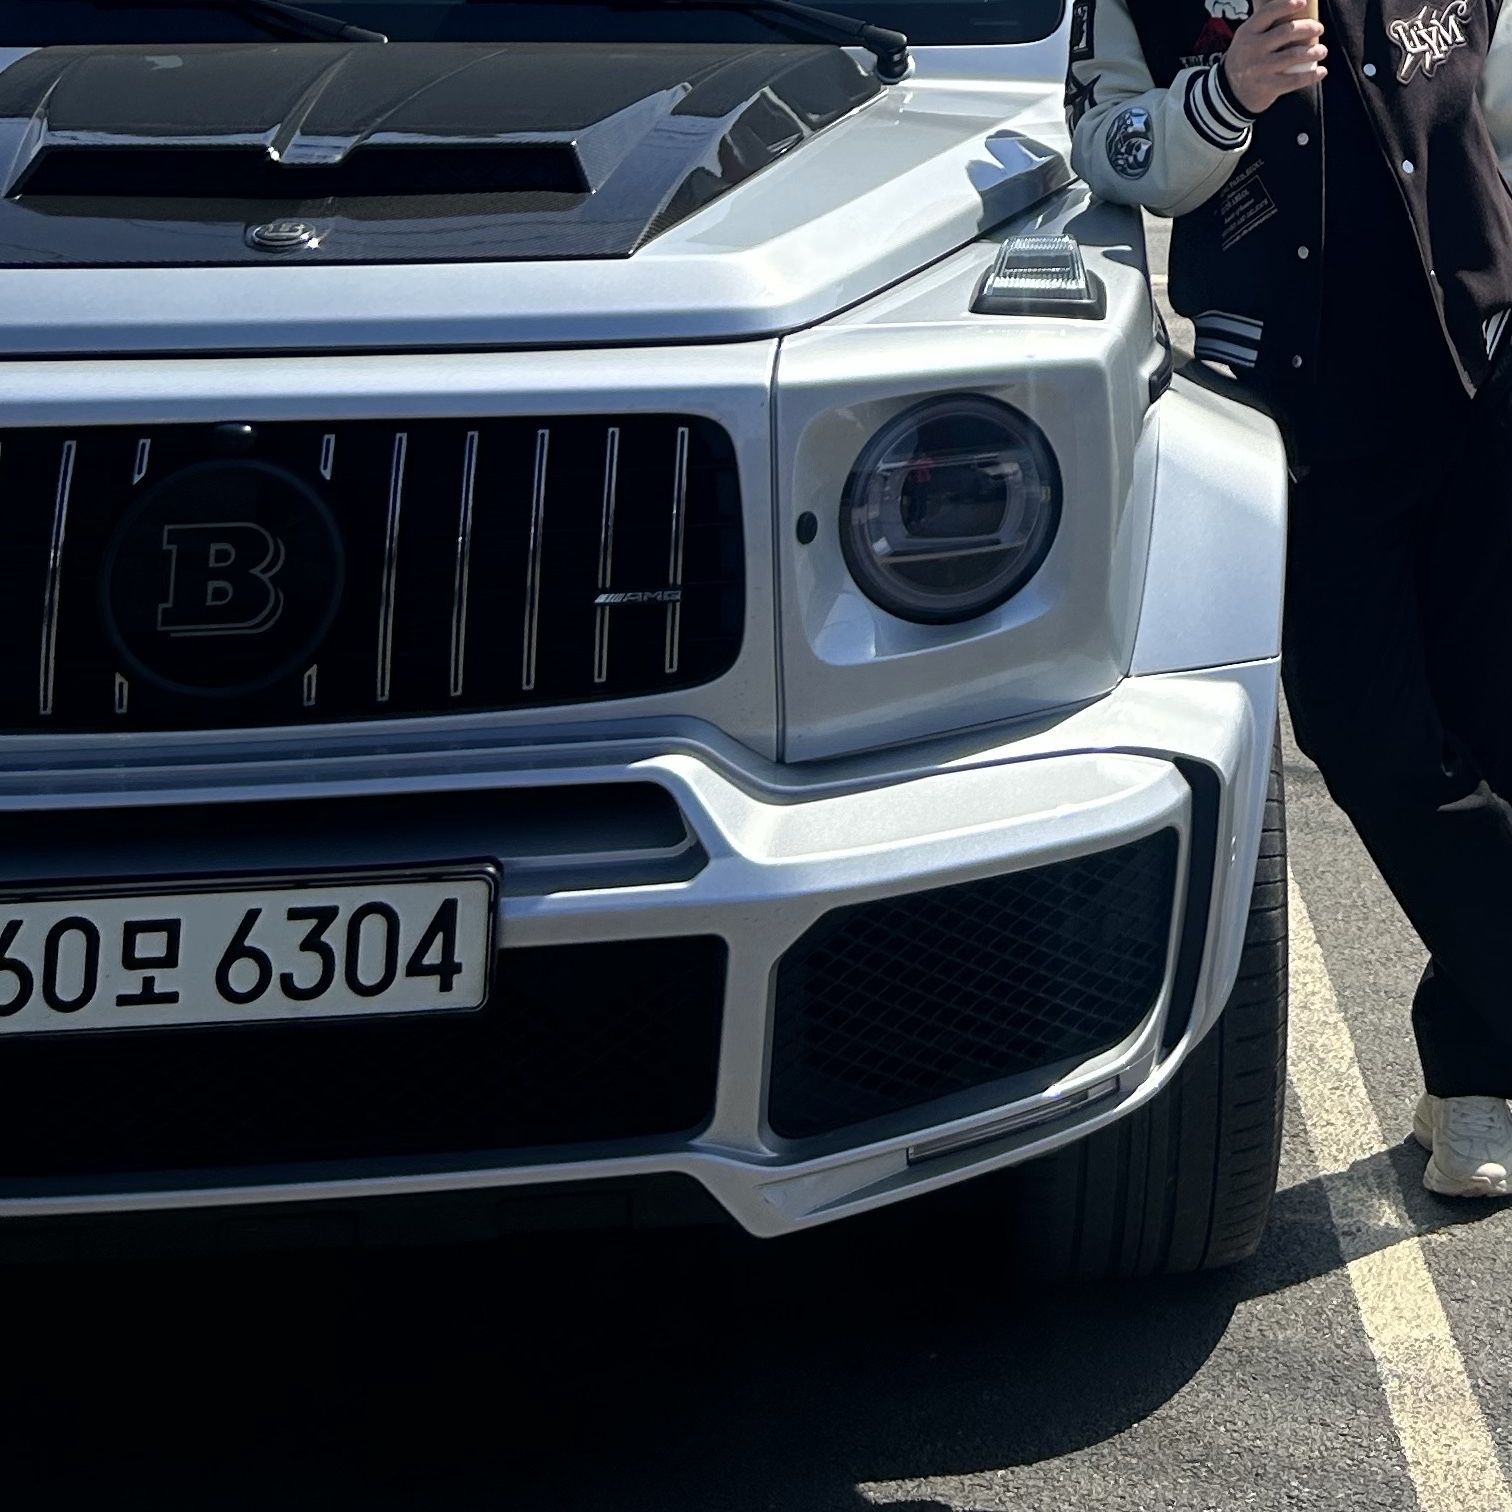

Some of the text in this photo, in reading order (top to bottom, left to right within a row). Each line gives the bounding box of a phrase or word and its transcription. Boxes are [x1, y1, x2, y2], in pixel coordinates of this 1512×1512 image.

[157, 522, 286, 637] B
[622, 590, 682, 603] AMG
[215, 897, 463, 1005] 6304
